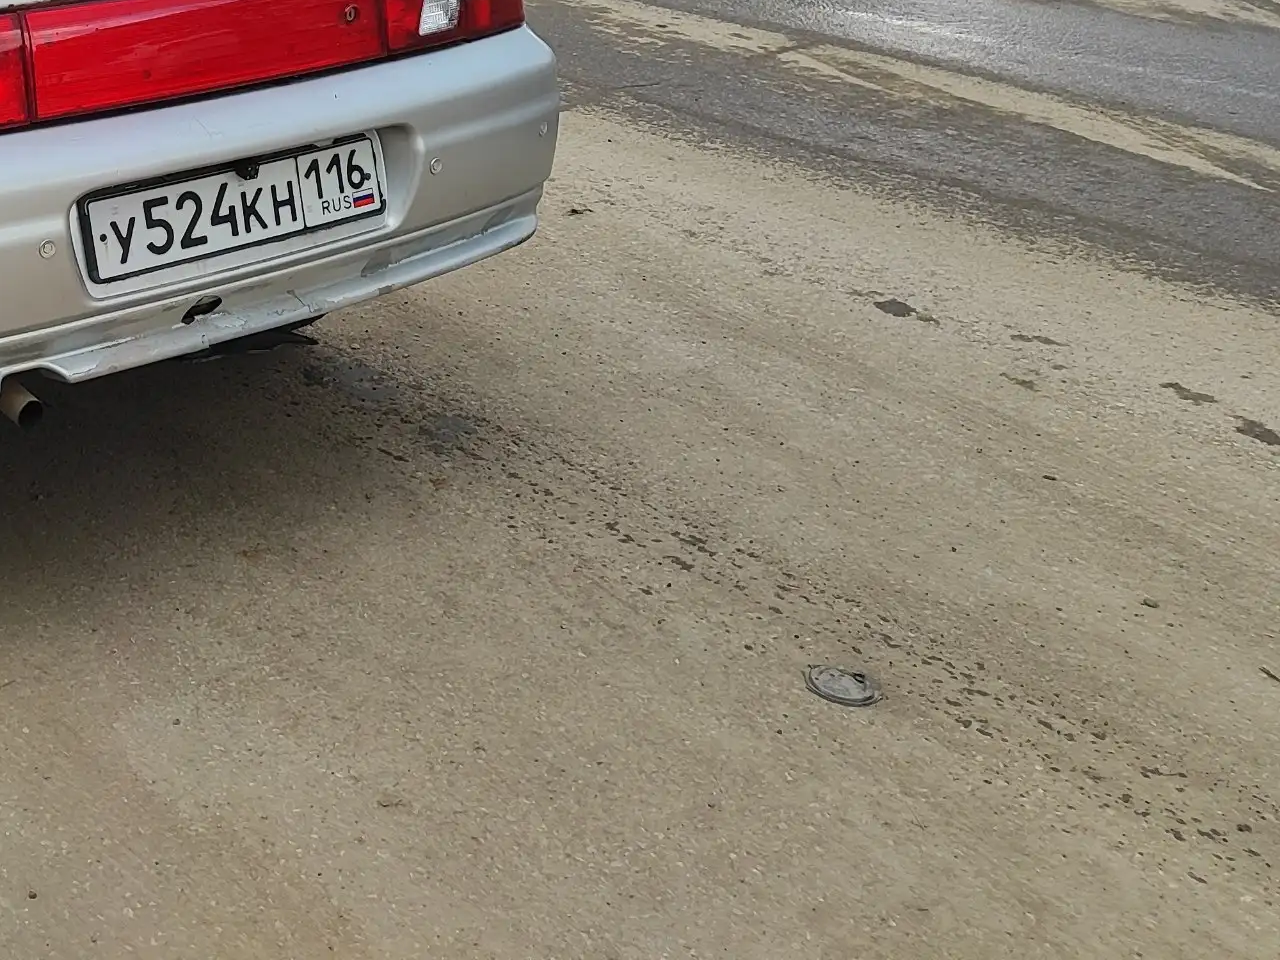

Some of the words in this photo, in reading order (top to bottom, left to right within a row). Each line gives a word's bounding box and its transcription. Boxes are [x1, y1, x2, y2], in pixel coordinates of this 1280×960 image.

[109, 180, 298, 265] У524КН
[303, 148, 366, 199] 116
[321, 194, 353, 216] RUS
